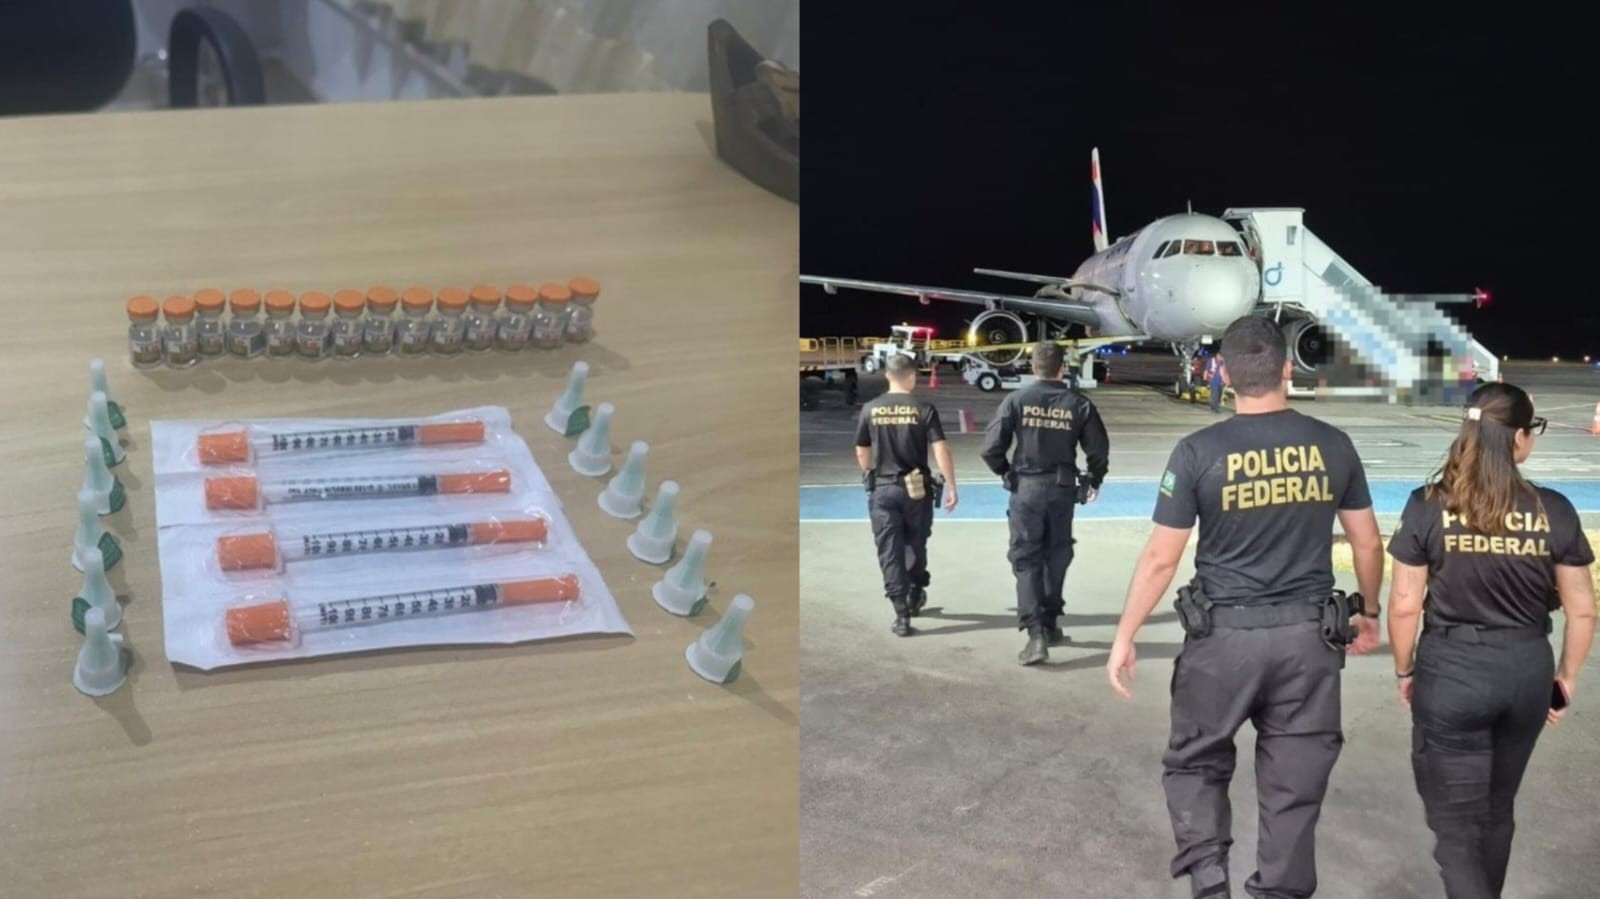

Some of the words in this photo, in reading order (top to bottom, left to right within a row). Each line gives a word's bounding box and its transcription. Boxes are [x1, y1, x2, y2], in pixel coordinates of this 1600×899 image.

[871, 416, 918, 426] FEDERAL
[1023, 405, 1073, 420] POLÍCIA
[1022, 417, 1072, 431] FEDERAL
[1221, 475, 1334, 512] FEDERAL
[1441, 509, 1551, 533] PCIA
[1443, 534, 1551, 556] FEDERAL
